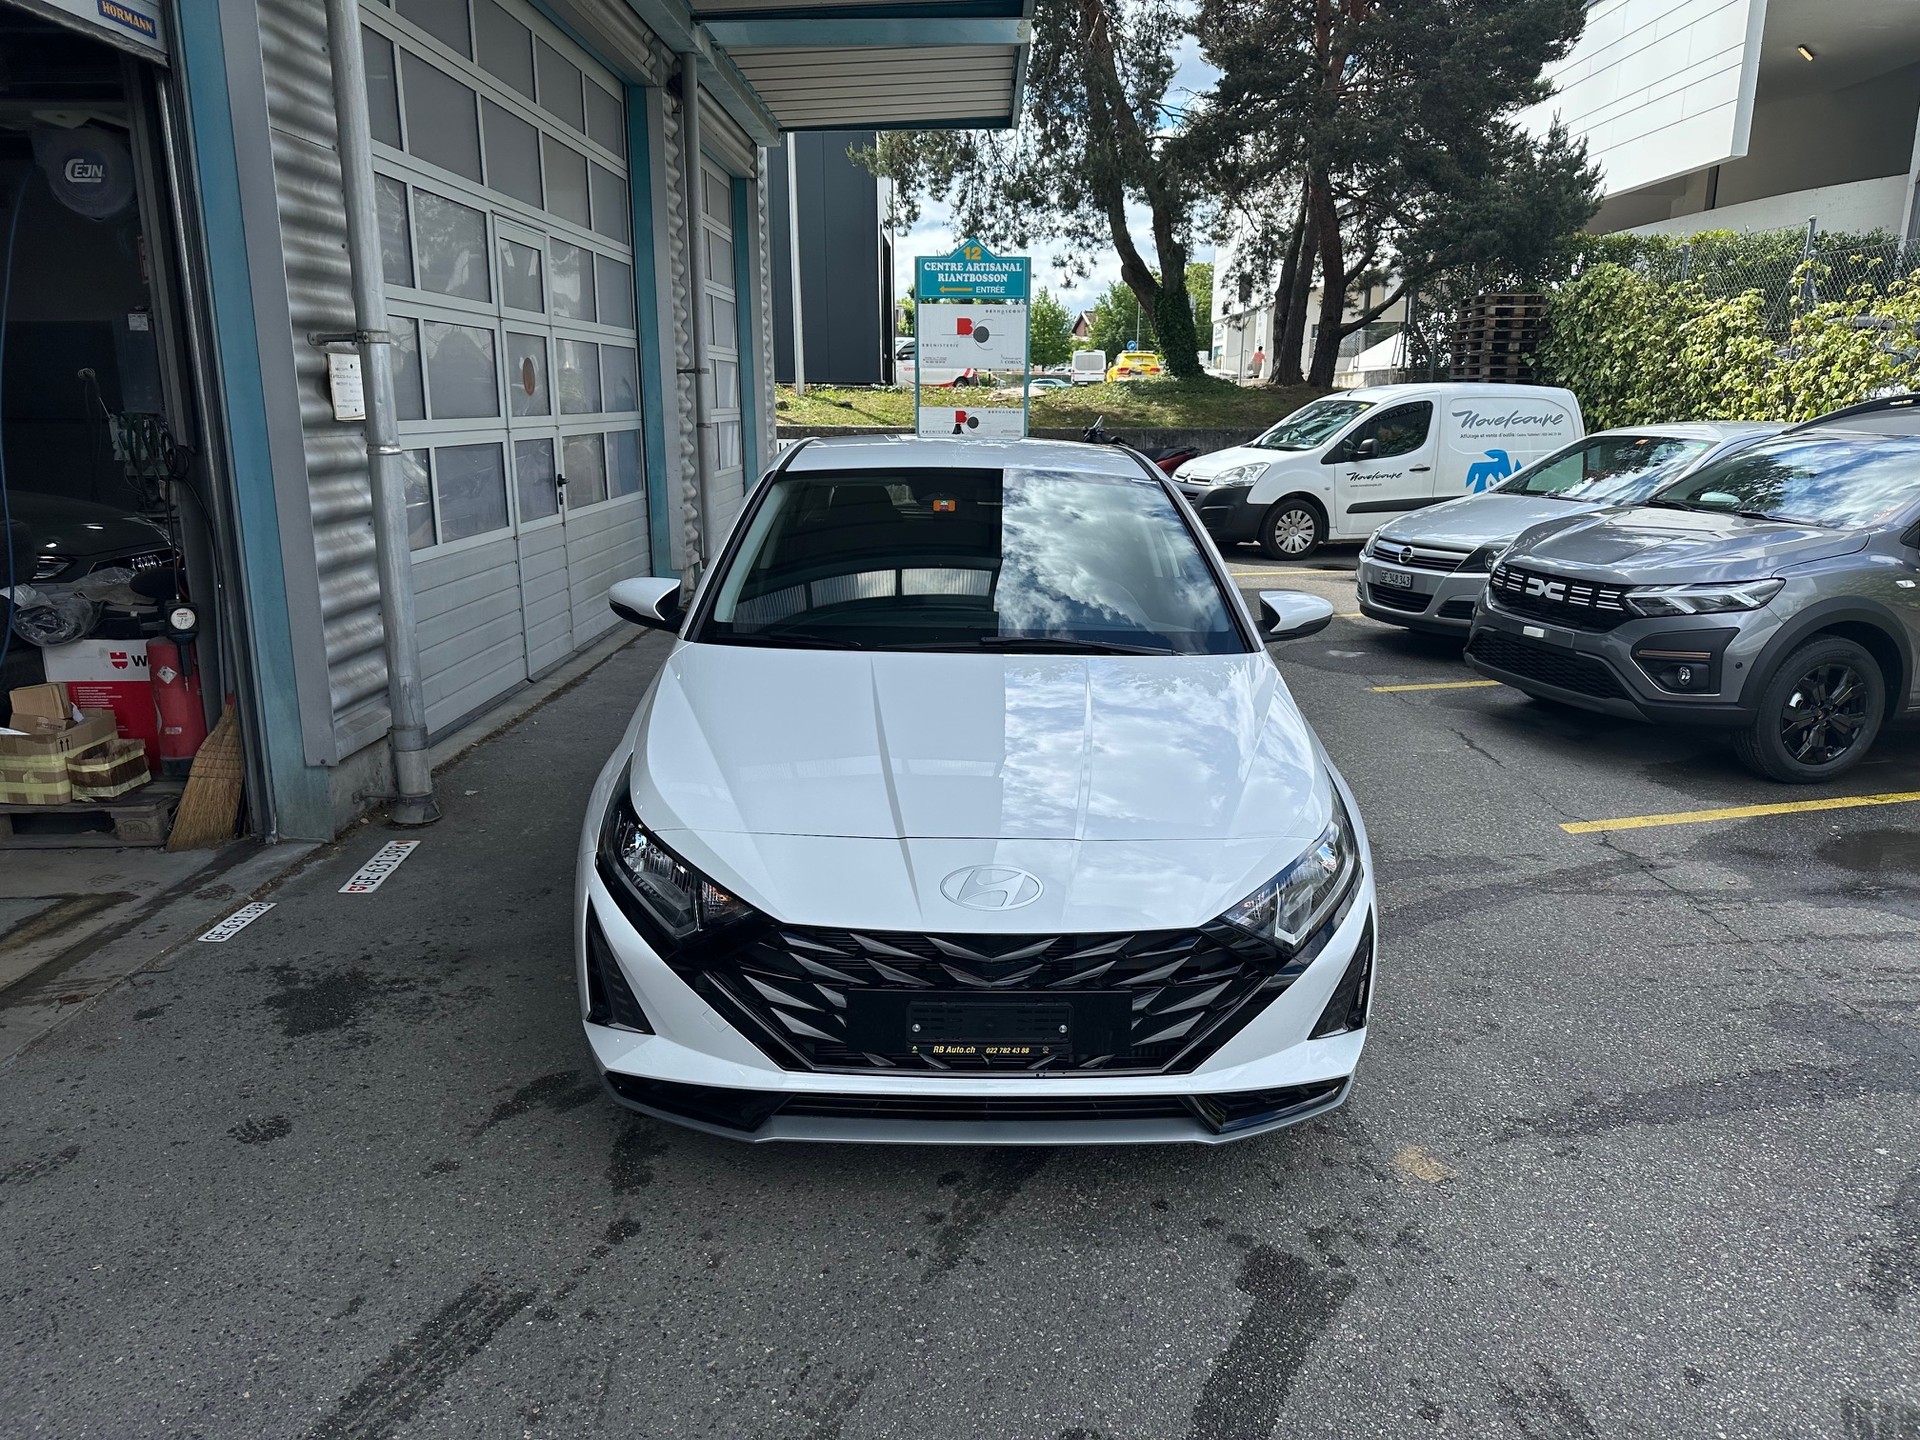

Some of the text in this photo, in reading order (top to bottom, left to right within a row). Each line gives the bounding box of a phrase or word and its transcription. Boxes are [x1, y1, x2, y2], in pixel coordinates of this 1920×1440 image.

[65, 158, 104, 183] CEJN
[963, 247, 982, 260] 12
[924, 262, 1022, 272] CENTRE ARTISANAL
[938, 273, 1008, 283] RIANTBOSSON
[976, 285, 1006, 293] ENTRÉE
[933, 1045, 944, 1054] RB
[945, 1045, 976, 1054] Auto.ch
